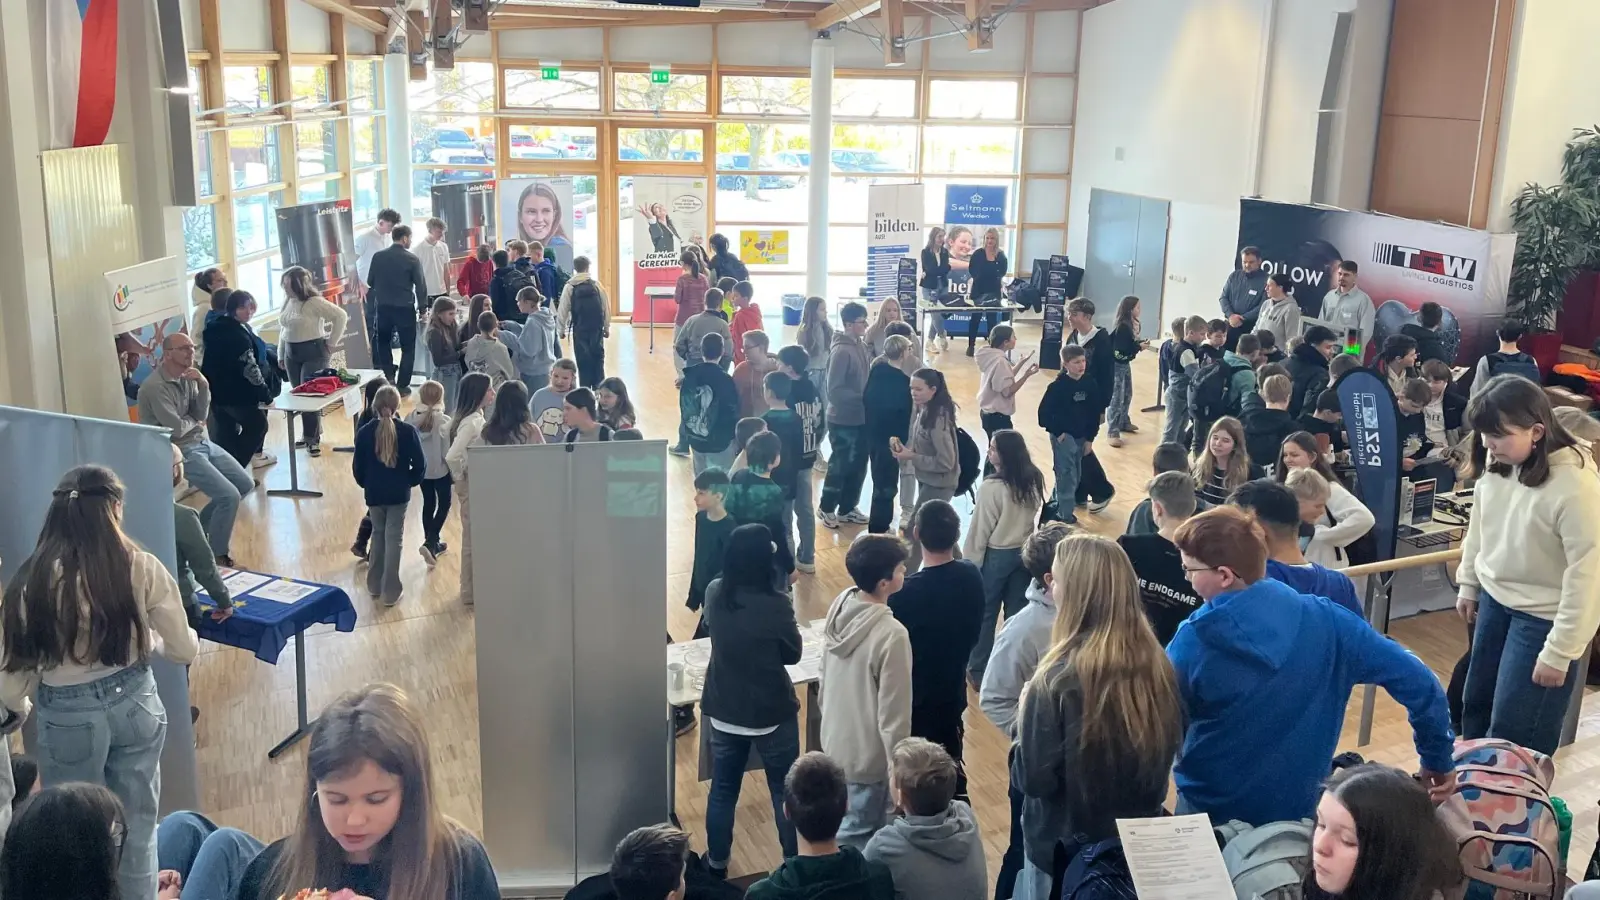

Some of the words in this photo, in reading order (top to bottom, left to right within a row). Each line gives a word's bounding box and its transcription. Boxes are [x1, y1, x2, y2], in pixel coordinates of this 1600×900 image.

[466, 183, 493, 192] Leistritz
[317, 206, 348, 216] Leistritz
[951, 203, 1002, 212] Seltmann
[874, 219, 920, 233] bilden.
[1260, 260, 1324, 287] OLLOW
[1427, 275, 1474, 291] LOGISTICS
[1148, 582, 1197, 606] ENDGAME
